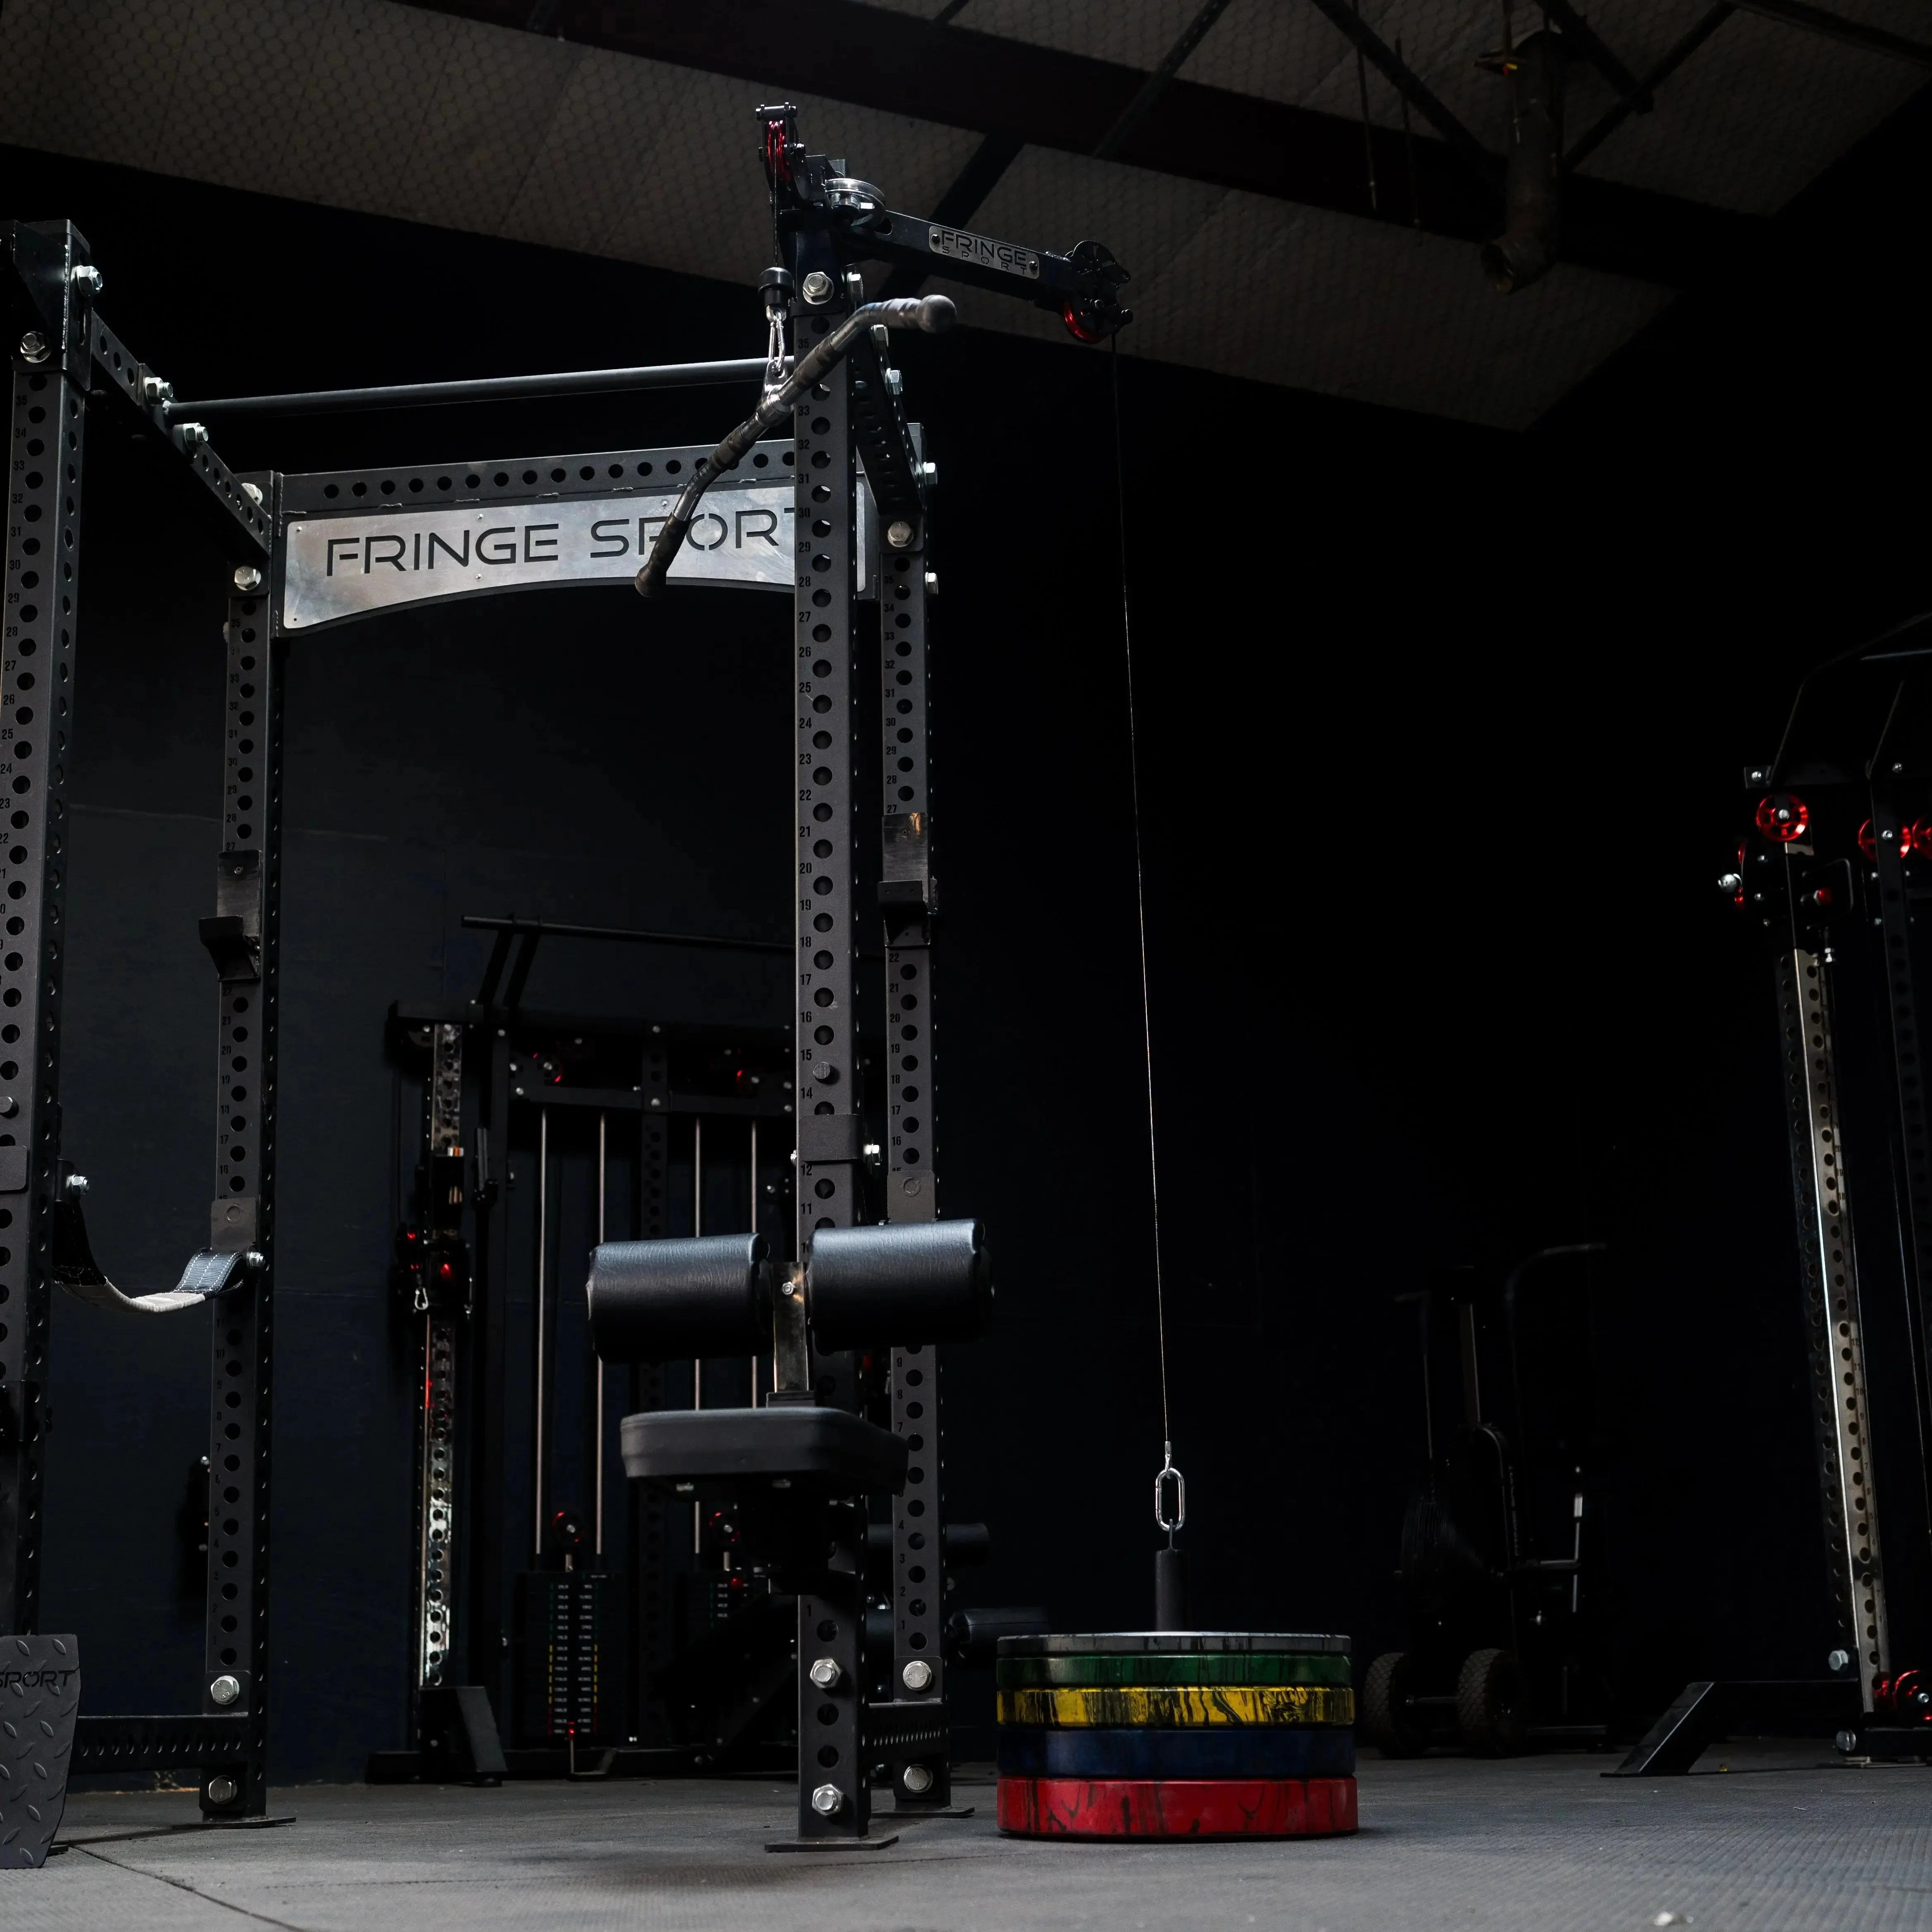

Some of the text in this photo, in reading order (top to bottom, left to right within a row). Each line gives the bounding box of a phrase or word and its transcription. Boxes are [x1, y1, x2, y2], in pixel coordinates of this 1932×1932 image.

[942, 230, 1026, 267] FRINGE
[942, 246, 1027, 275] SPORT
[798, 339, 809, 349] 35
[798, 406, 810, 415] 33
[15, 428, 26, 438] 34
[798, 440, 810, 450] 32
[14, 461, 24, 471] 33
[798, 474, 809, 484] 31
[12, 494, 23, 504] 32
[799, 508, 811, 518] 30
[11, 527, 21, 537] 31
[326, 507, 794, 577] FRINGE SPOR
[799, 542, 811, 552] 29
[10, 560, 20, 570] 30
[799, 577, 811, 587] 28
[8, 593, 19, 603] 29
[884, 604, 894, 612] 34
[799, 612, 811, 622] 27
[7, 626, 17, 637] 28
[885, 632, 894, 641] 33
[799, 647, 811, 657] 26
[5, 660, 16, 671] 27
[885, 661, 895, 669] 32
[799, 682, 811, 693] 25
[3, 694, 15, 705] 26
[229, 702, 239, 711] 32
[799, 718, 812, 728] 24
[886, 718, 896, 726] 30
[2, 728, 13, 739] 25
[229, 729, 237, 739] 31
[887, 746, 897, 755] 29
[228, 758, 237, 766] 30
[799, 754, 811, 764] 23
[0, 763, 12, 774] 24
[887, 775, 897, 784] 28
[800, 790, 812, 801] 22
[887, 804, 897, 813] 27
[800, 826, 811, 837] 21
[226, 842, 235, 851] 27
[800, 863, 812, 874] 20
[800, 899, 811, 910] 19
[800, 936, 812, 947] 18
[889, 953, 899, 962] 22
[800, 974, 812, 985] 17
[889, 983, 899, 992] 21
[222, 1016, 231, 1025] 21
[801, 1011, 812, 1023] 16
[890, 1014, 900, 1023] 20
[222, 1045, 231, 1054] 20
[890, 1044, 900, 1053] 19
[801, 1049, 812, 1061] 15
[221, 1075, 230, 1084] 19
[891, 1074, 900, 1084] 18
[801, 1087, 813, 1099] 14
[892, 1105, 901, 1115] 17
[220, 1135, 228, 1144] 17
[892, 1136, 901, 1145] 16
[219, 1165, 228, 1174] 16
[801, 1164, 813, 1176] 12
[801, 1203, 812, 1215] 11
[216, 1349, 225, 1358] 10
[897, 1390, 903, 1399] 8
[217, 1412, 222, 1421] 8
[898, 1422, 903, 1432] 7
[216, 1443, 221, 1452] 7
[899, 1520, 904, 1530] 4
[900, 1554, 905, 1563] 3
[900, 1587, 906, 1597] 2
[806, 1605, 811, 1617] 1
[901, 1621, 905, 1630] 1
[0, 1670, 76, 1688] PORT
